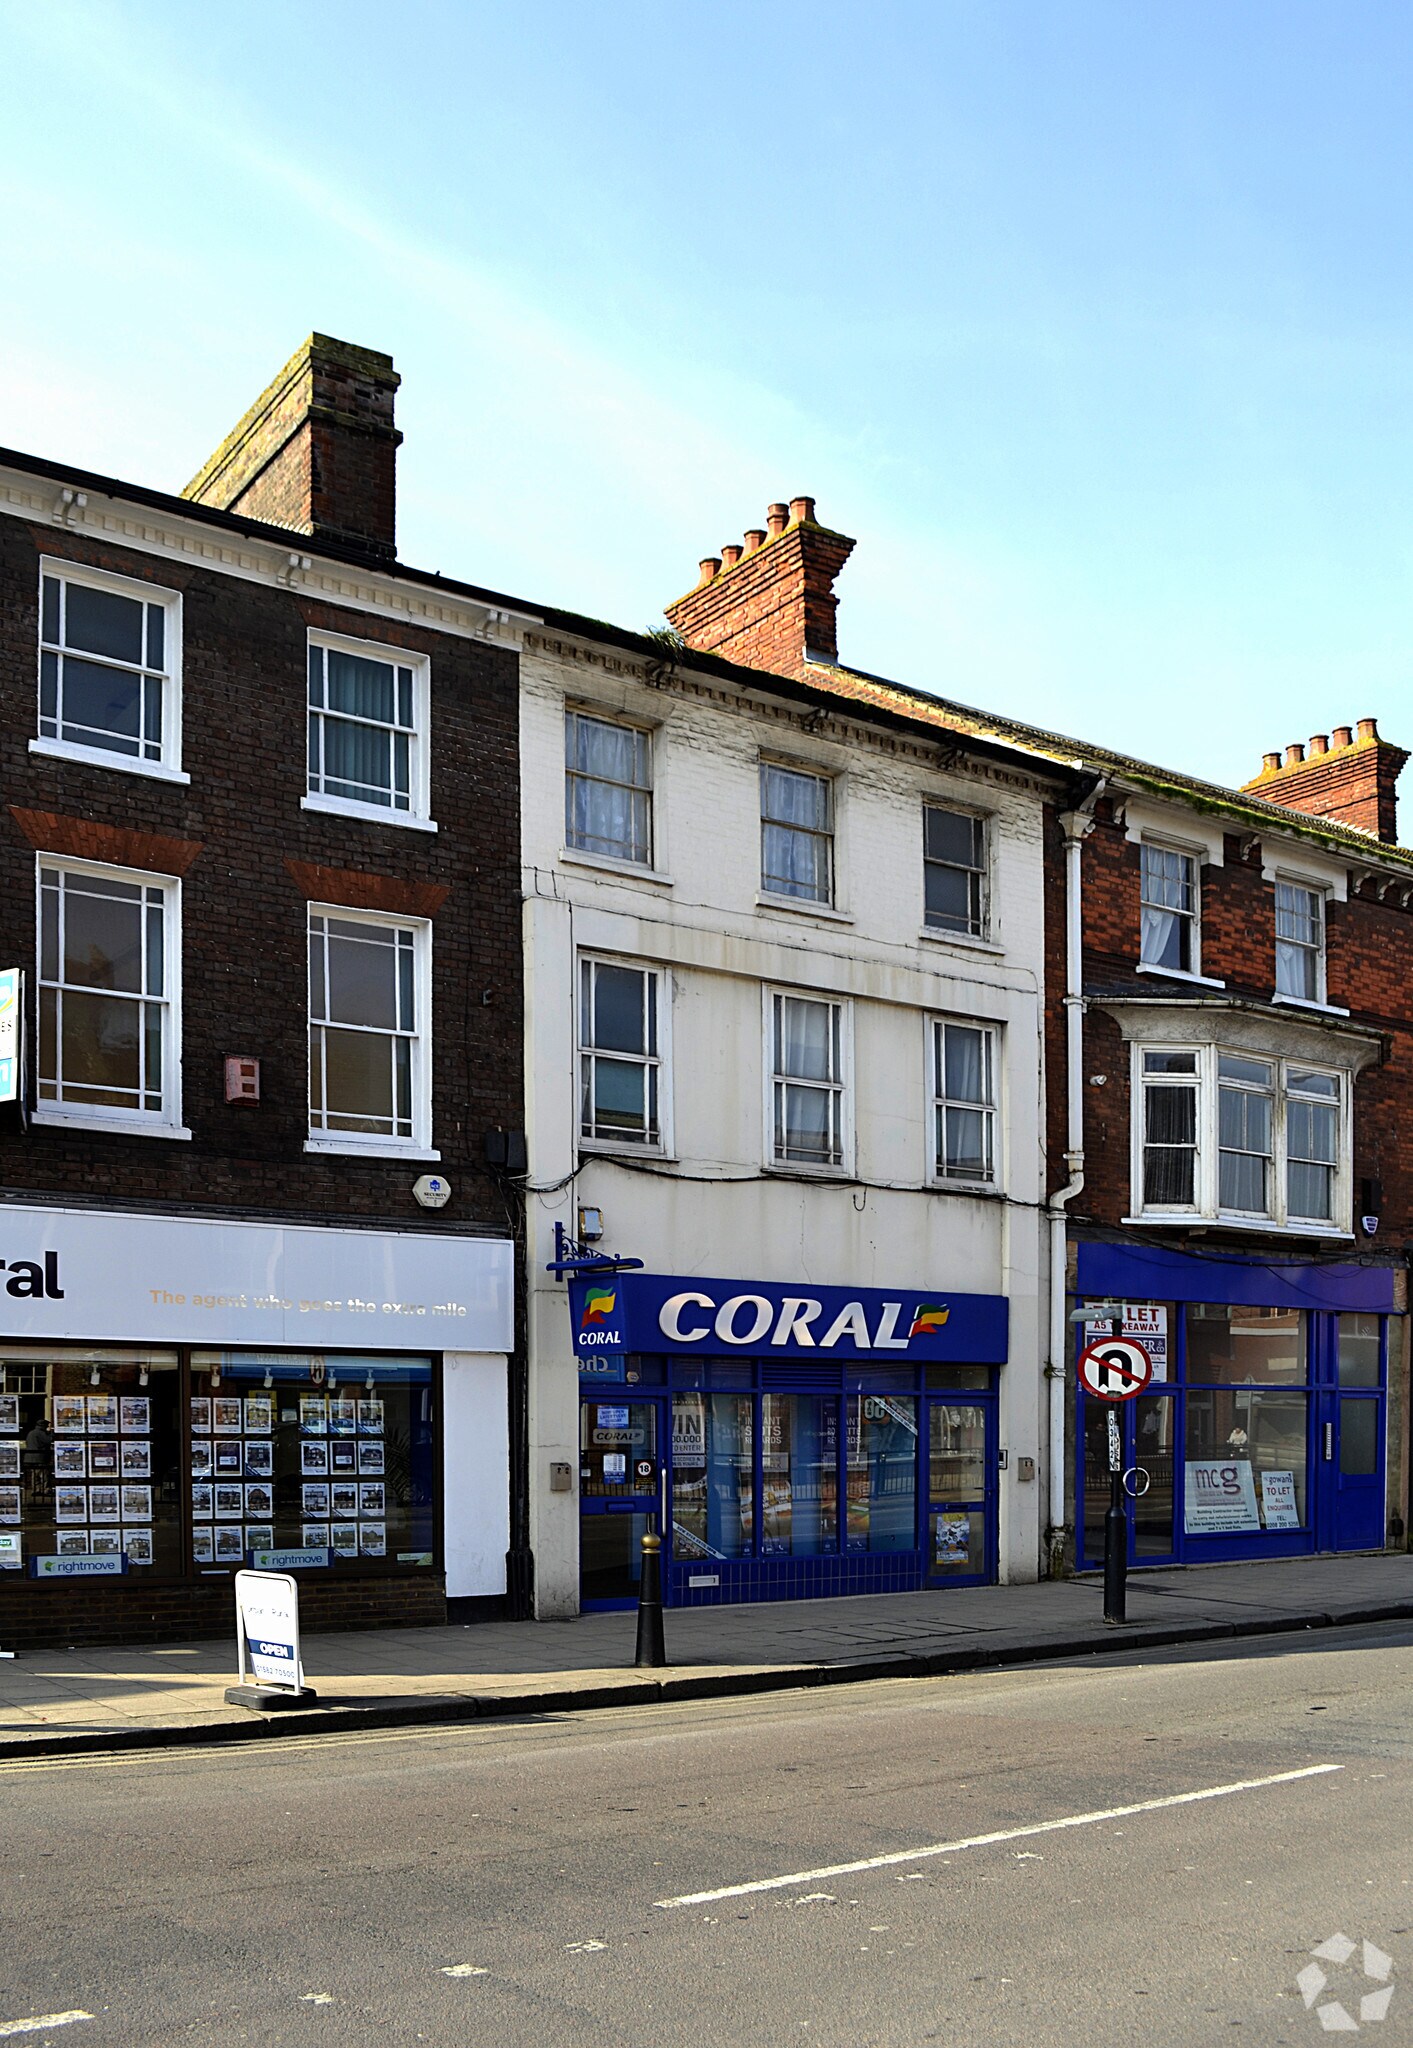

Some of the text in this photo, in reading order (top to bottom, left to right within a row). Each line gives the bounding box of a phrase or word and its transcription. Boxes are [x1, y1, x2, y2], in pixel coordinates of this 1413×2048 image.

[149, 1290, 467, 1317] The agent who goes the extra mile
[658, 1292, 909, 1349] CORAL
[1126, 1307, 1159, 1322] LET
[579, 1331, 621, 1345] CORAL
[640, 1465, 650, 1473] 18
[1195, 1467, 1241, 1495] mcg
[1278, 1487, 1290, 1495] LET
[272, 1555, 322, 1566] rightmove
[58, 1562, 115, 1574] rightmove
[260, 1643, 288, 1658] OPEN
